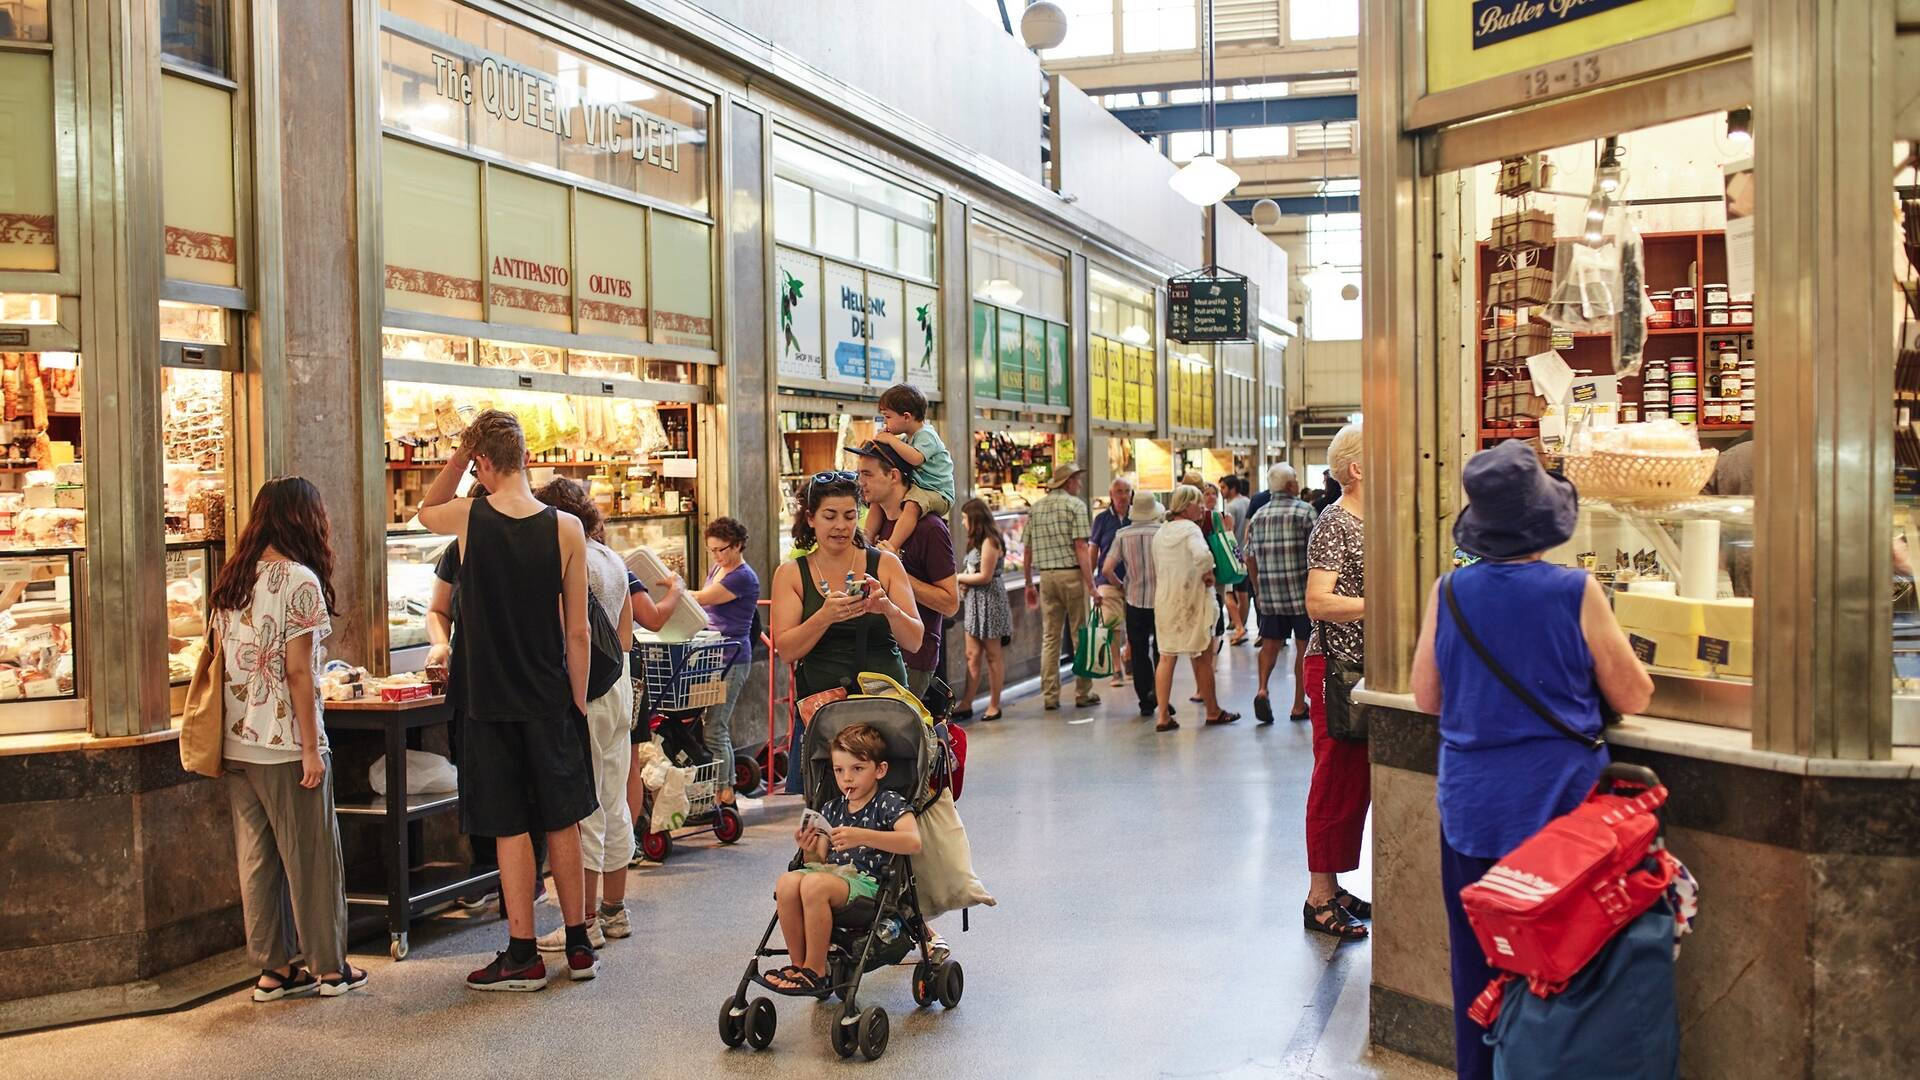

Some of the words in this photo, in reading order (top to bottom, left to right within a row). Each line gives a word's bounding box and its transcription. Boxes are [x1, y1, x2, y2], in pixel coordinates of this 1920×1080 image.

[1475, 0, 1546, 37] Butter
[1525, 55, 1601, 99] 12-13
[432, 54, 472, 105] The
[481, 57, 572, 139] QUEEN
[580, 96, 622, 154] VIC
[631, 112, 680, 173] DELI
[492, 256, 568, 287] ANTIPASTO
[589, 274, 632, 298] OLIVES
[841, 285, 886, 318] HELLENIC
[852, 315, 874, 340] DEI
